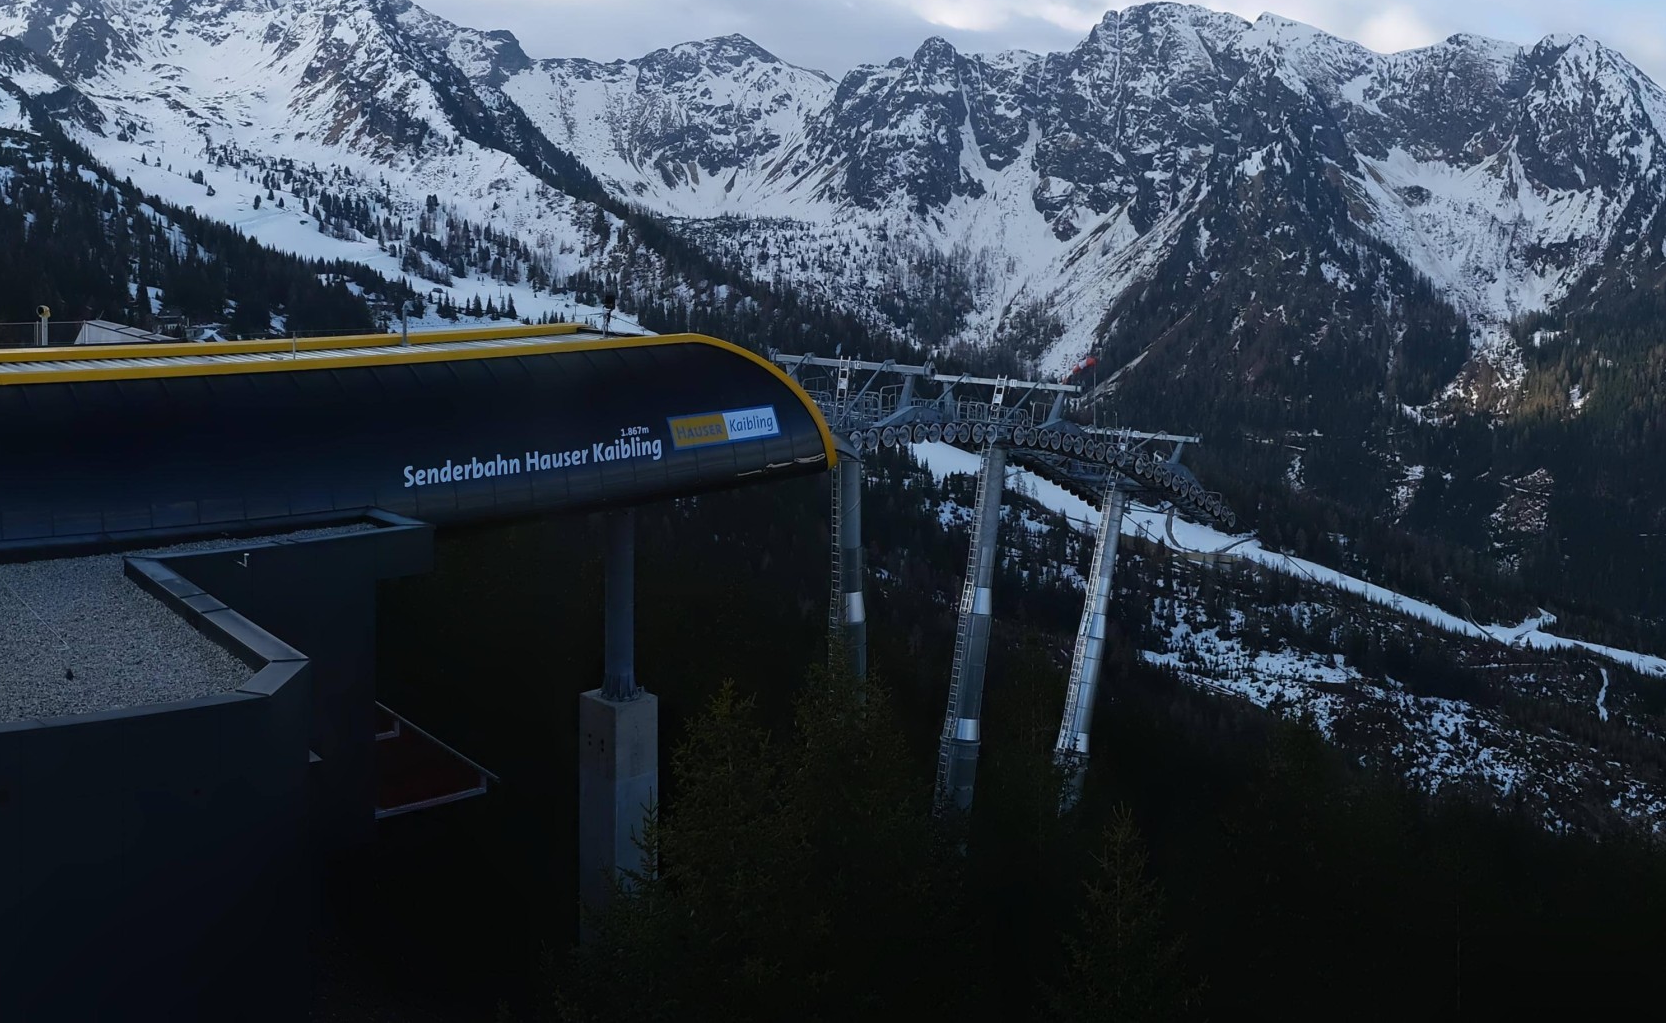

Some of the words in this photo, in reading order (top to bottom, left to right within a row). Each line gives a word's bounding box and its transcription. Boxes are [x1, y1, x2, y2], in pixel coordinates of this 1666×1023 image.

[620, 426, 650, 437] 1.867m
[676, 424, 724, 440] HAUSER
[729, 413, 774, 433] Kaibling
[403, 453, 521, 489] Senderbahn
[525, 446, 589, 472] Hauser
[593, 437, 662, 463] Kaibling
